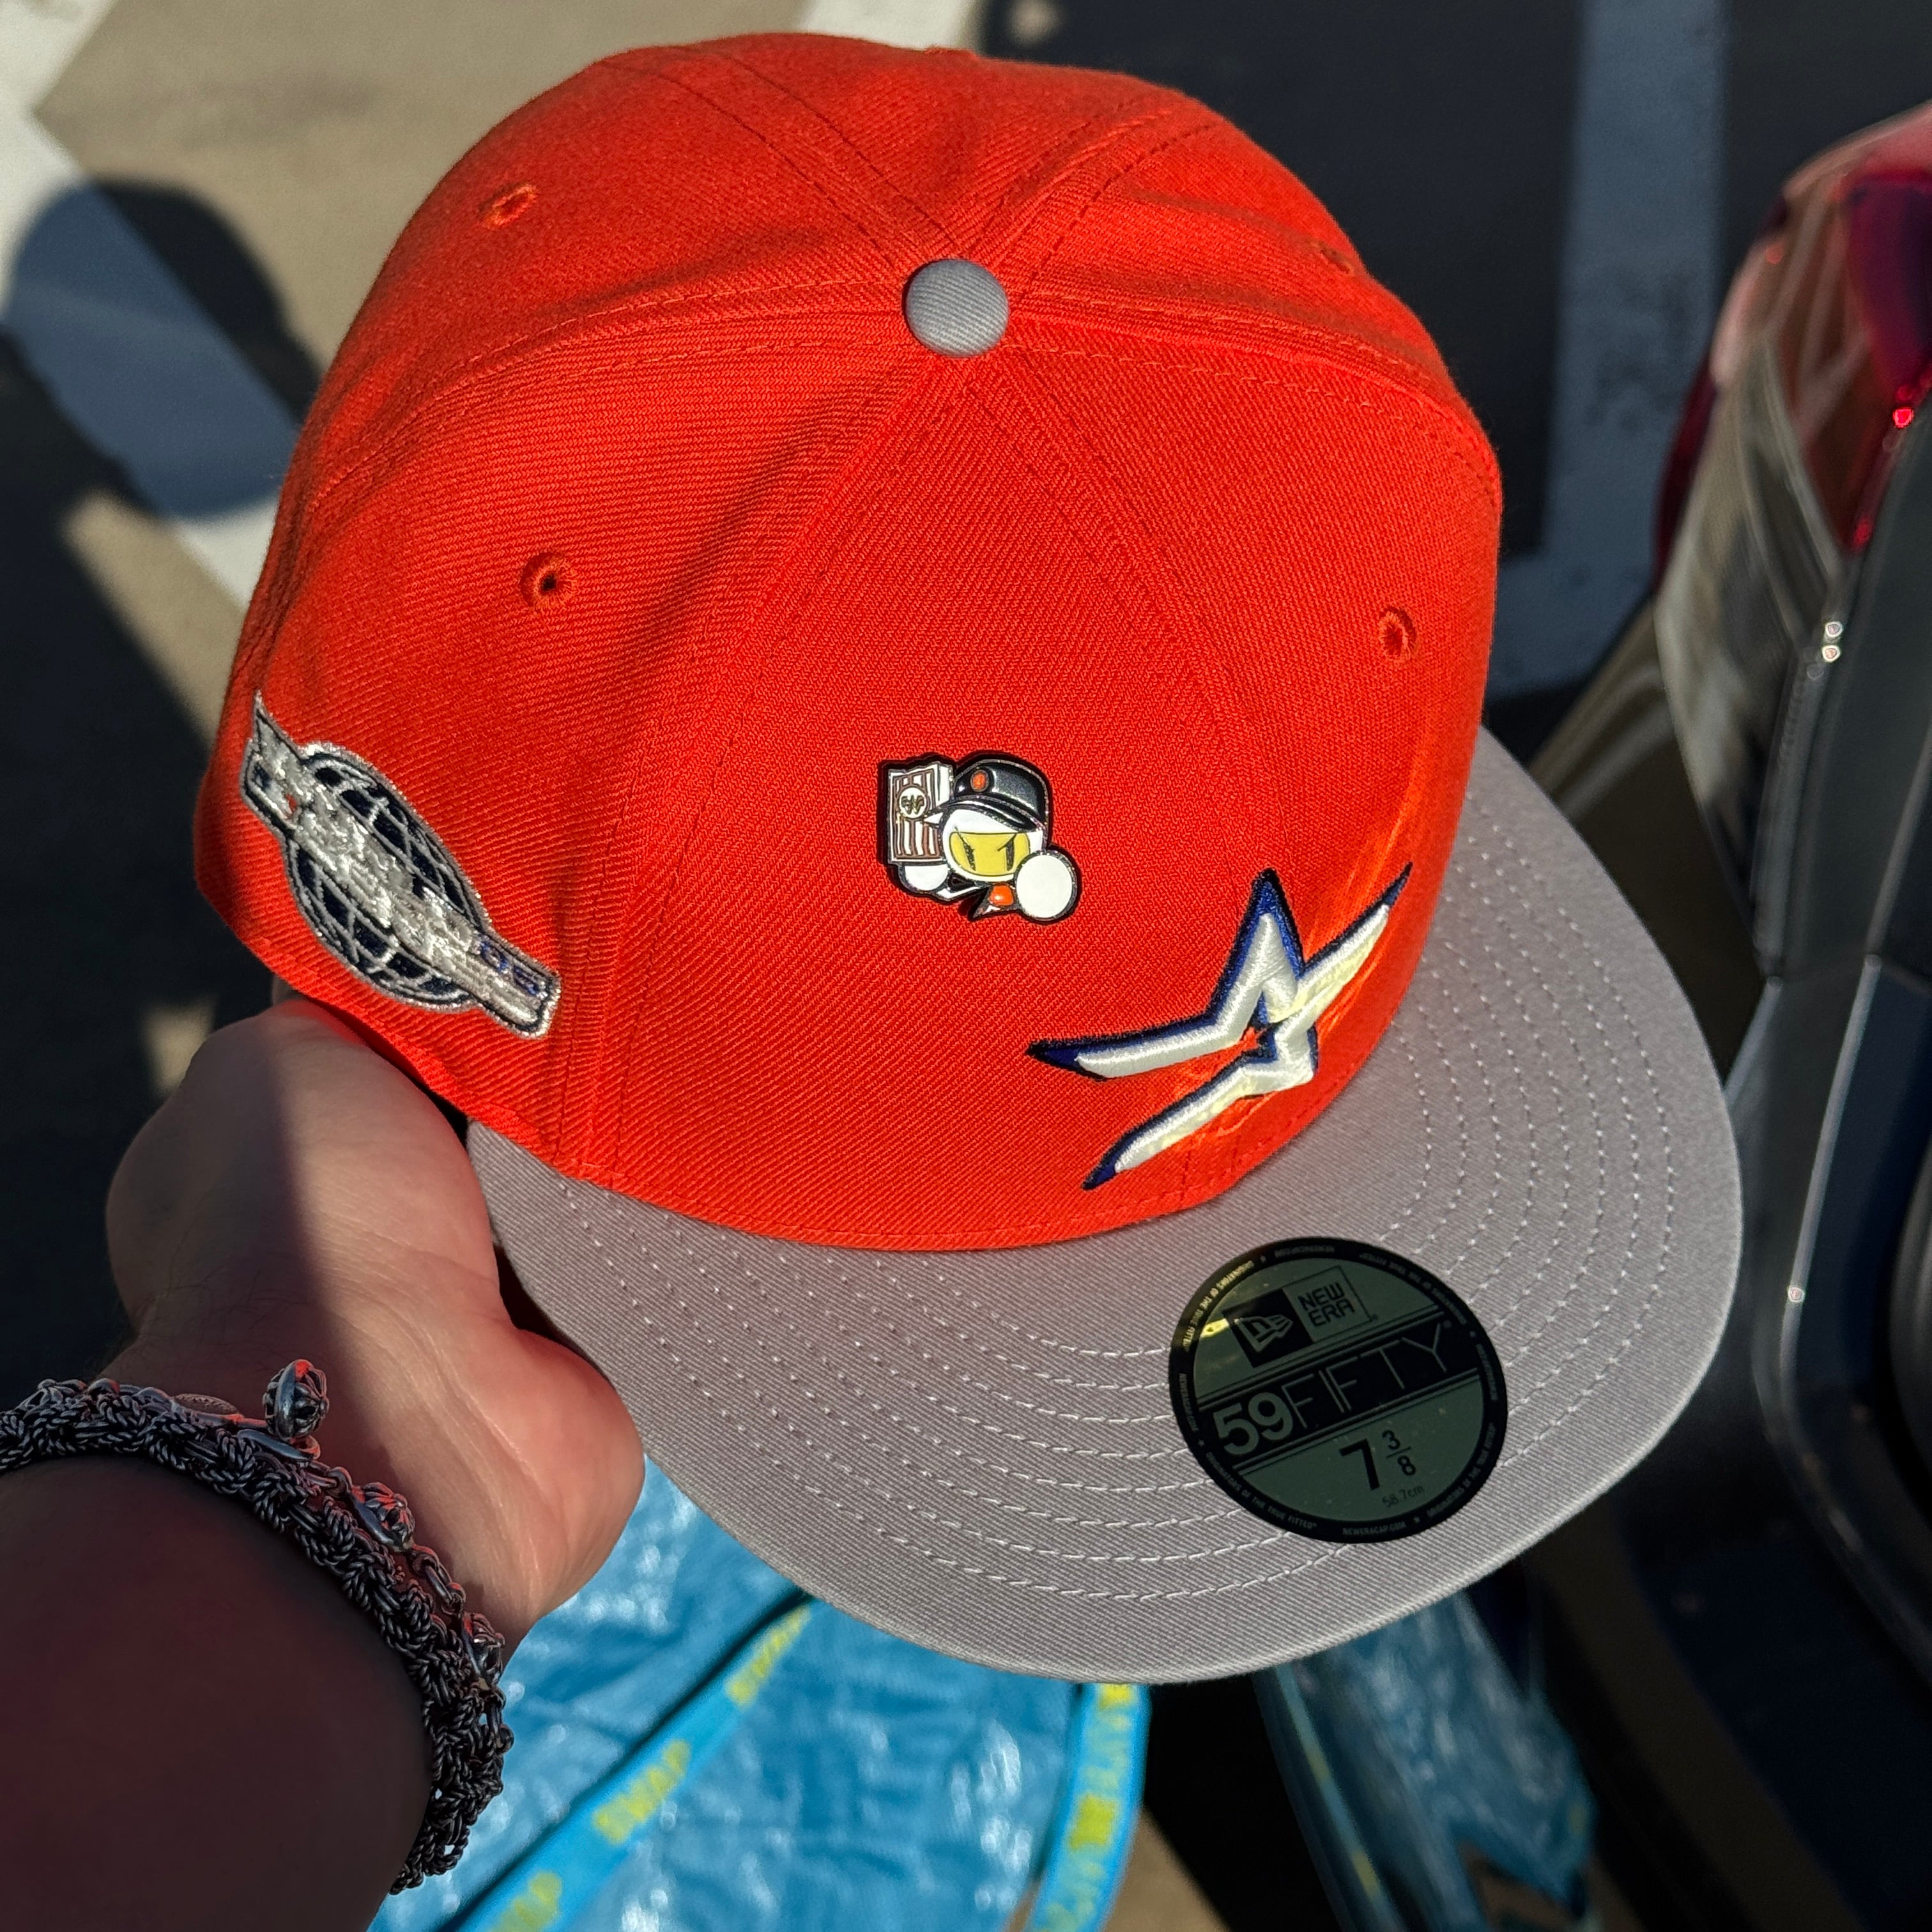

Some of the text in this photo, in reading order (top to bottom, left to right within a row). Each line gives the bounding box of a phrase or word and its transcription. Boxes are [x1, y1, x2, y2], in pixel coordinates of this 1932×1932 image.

[1298, 1282, 1345, 1311] NEW
[1308, 1298, 1355, 1326] ERA
[1213, 1322, 1446, 1455] 59FIFTY
[1340, 1439, 1380, 1491] 7
